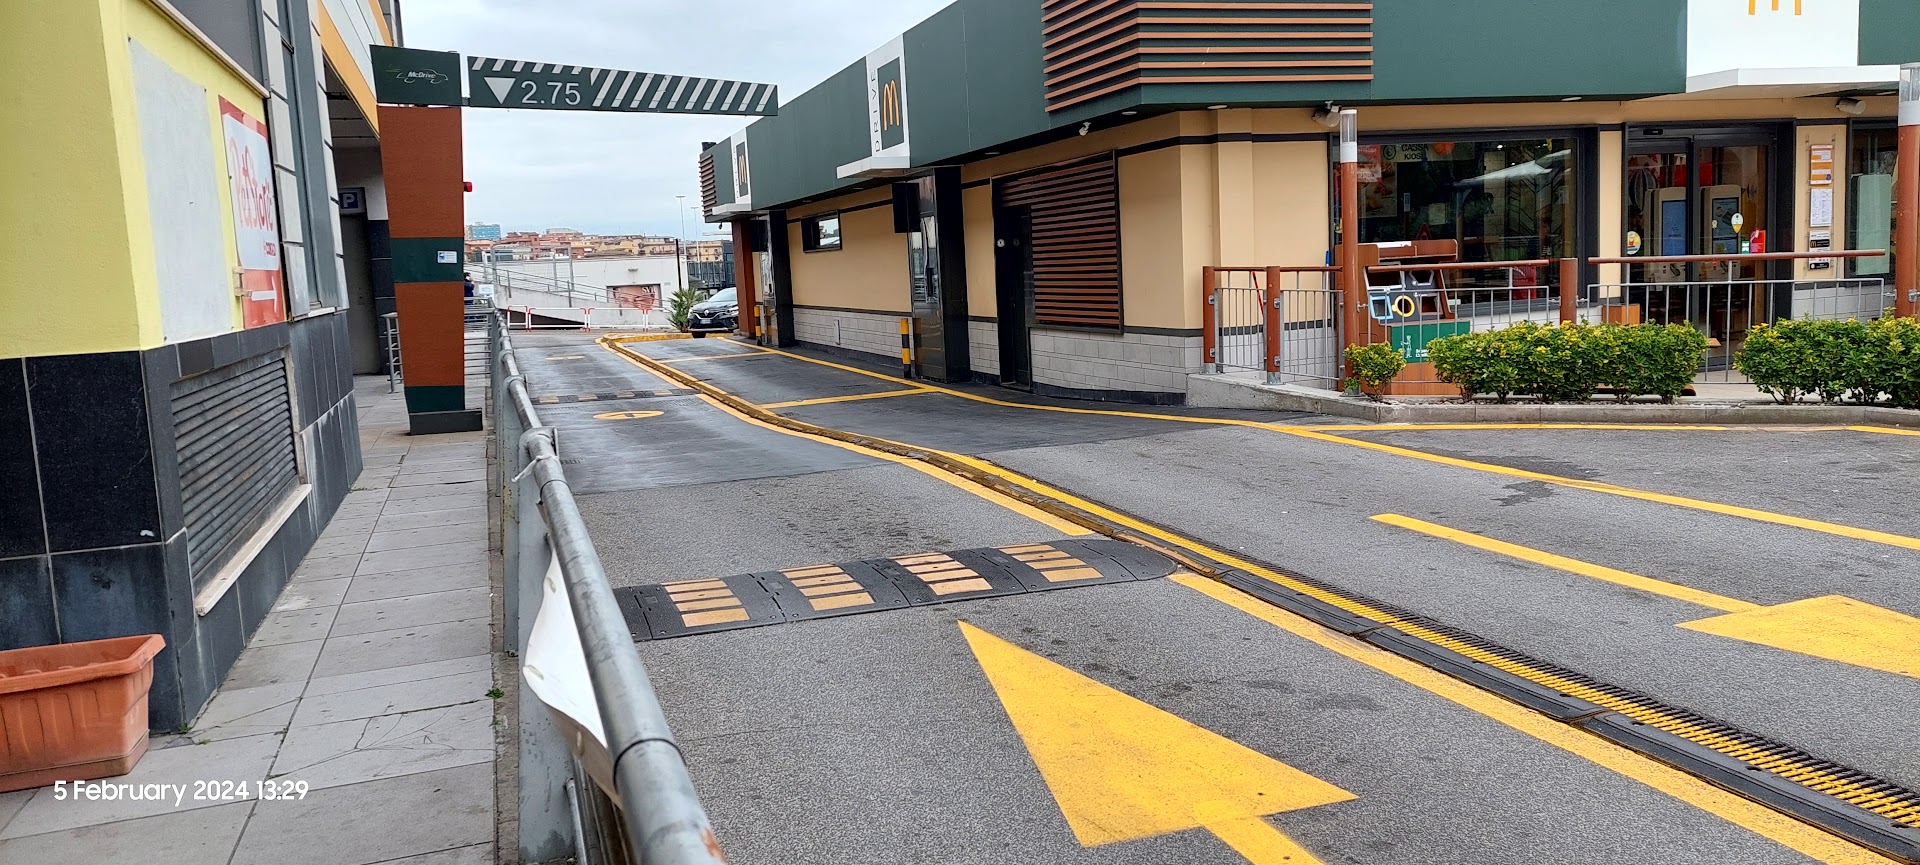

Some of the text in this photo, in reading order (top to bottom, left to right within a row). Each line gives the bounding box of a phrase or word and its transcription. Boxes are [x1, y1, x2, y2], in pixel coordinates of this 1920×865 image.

[521, 80, 581, 105] 2.75
[870, 68, 881, 153] DRIVE
[1401, 143, 1429, 152] CASSA
[342, 193, 355, 208] P
